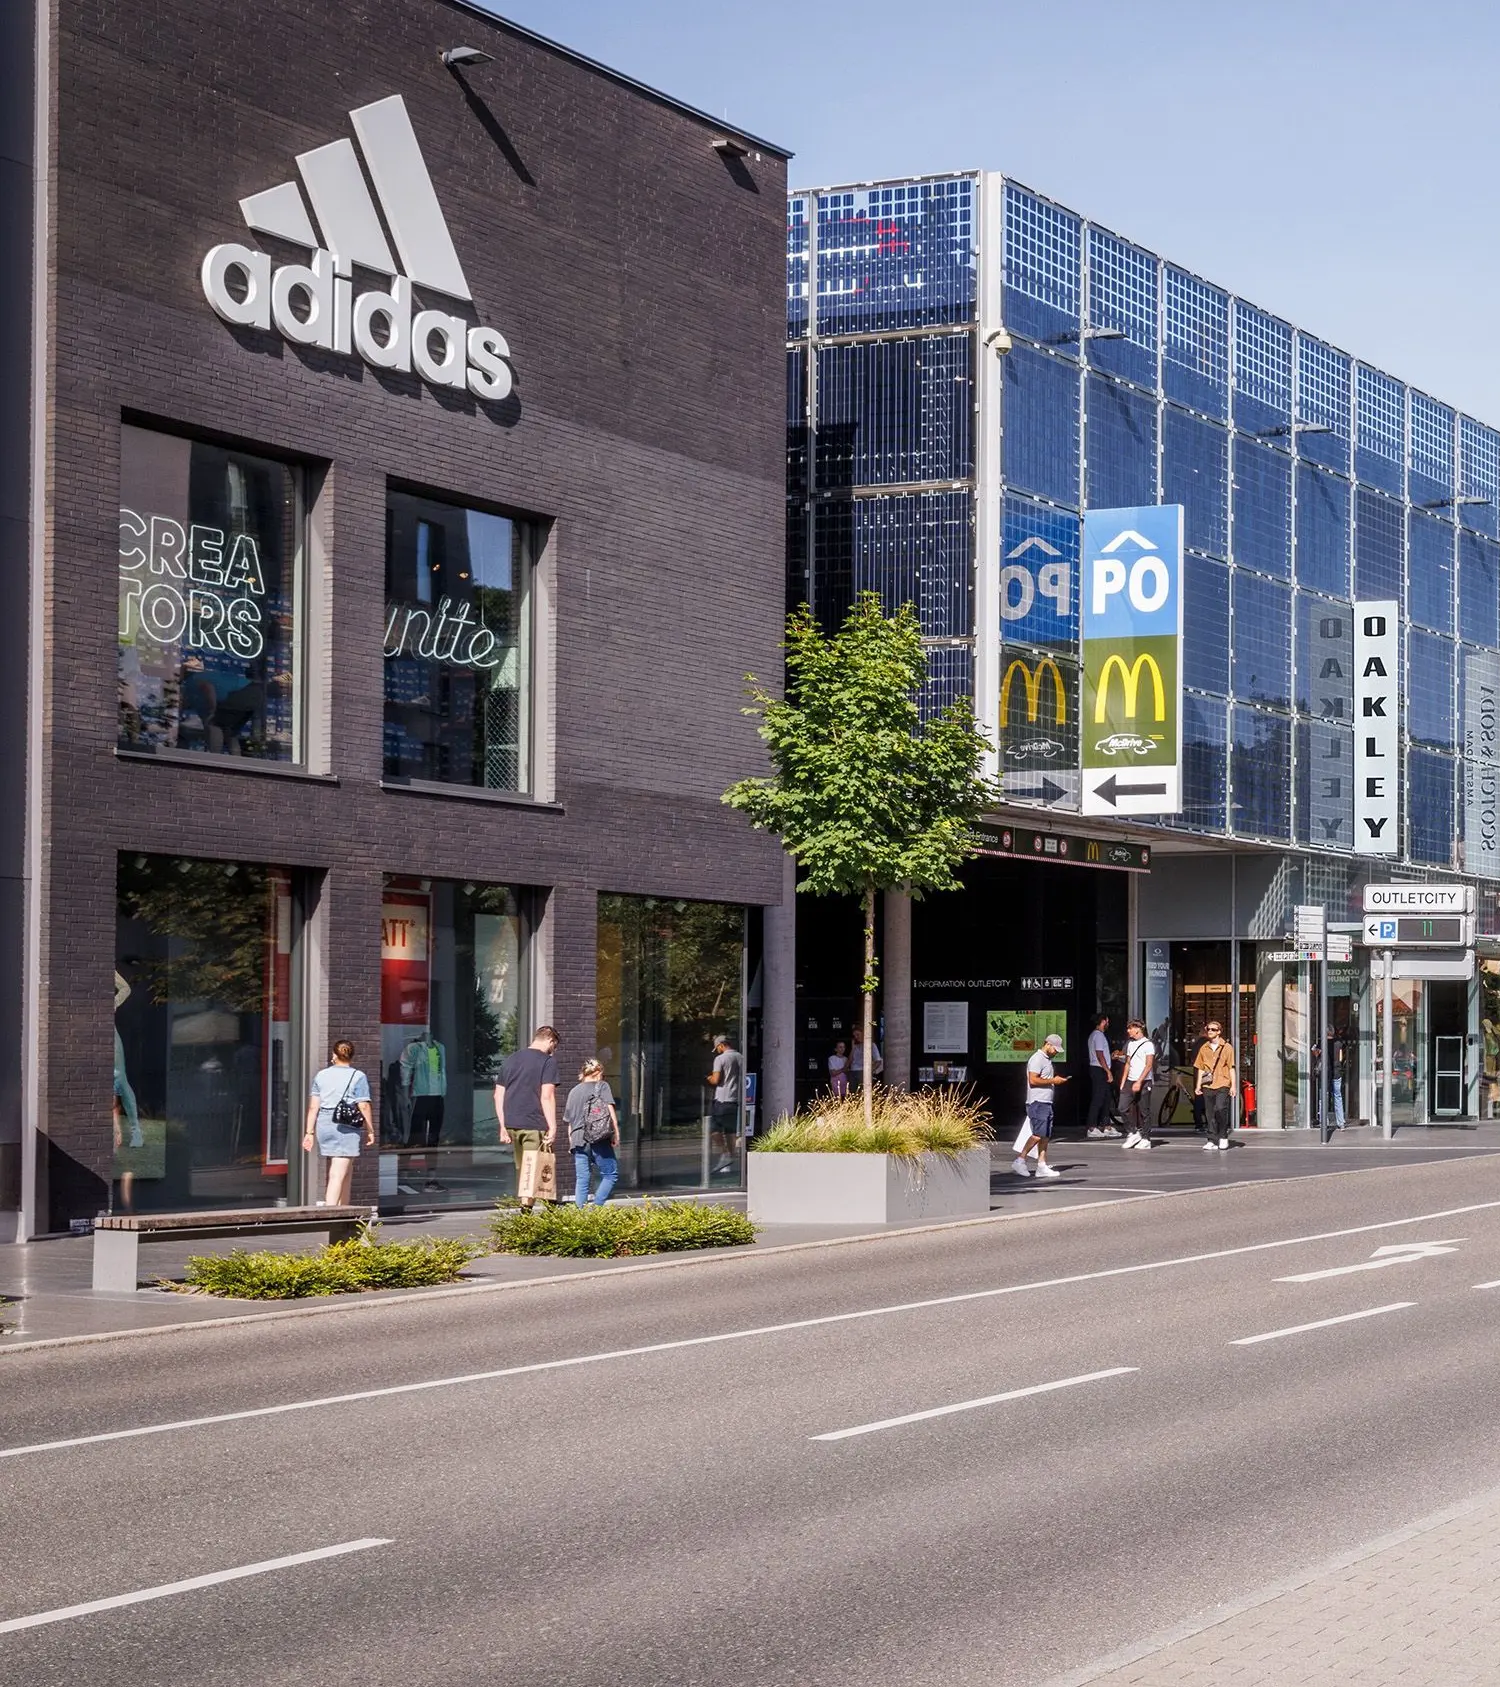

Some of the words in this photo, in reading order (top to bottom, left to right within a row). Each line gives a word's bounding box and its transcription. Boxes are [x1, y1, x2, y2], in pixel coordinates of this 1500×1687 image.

[202, 243, 513, 401] adidas
[119, 508, 266, 595] CREA
[119, 576, 264, 659] TORS
[1108, 737, 1143, 748] McDrive
[1362, 616, 1389, 839] OAKLEY
[1372, 892, 1457, 904] OUTLETCITY
[1423, 920, 1433, 937] 11
[919, 980, 966, 988] INFORMATION
[967, 980, 1012, 988] OUTLETCITY
